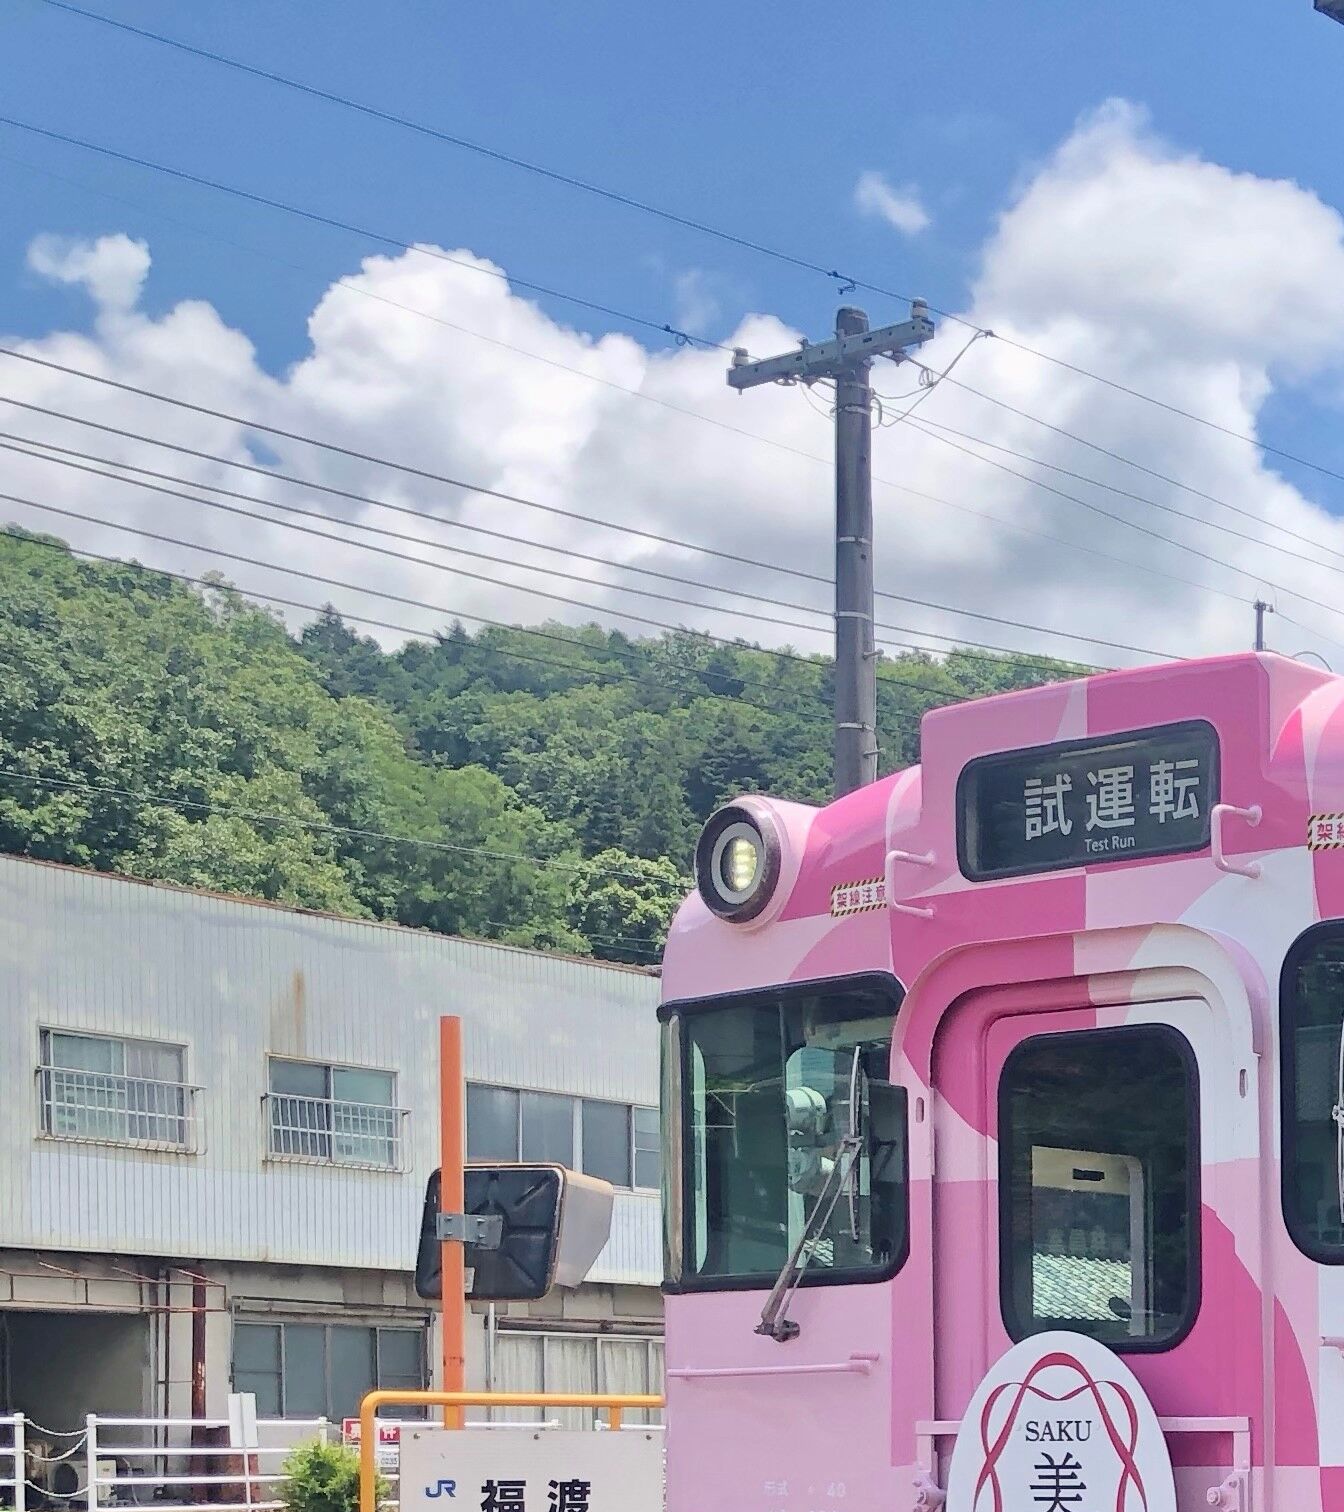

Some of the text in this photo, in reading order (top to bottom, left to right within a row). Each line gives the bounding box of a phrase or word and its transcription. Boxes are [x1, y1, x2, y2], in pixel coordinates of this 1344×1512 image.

[1023, 757, 1200, 842] 試運転
[1084, 833, 1135, 852] Test Run
[1025, 1420, 1093, 1442] SAKU
[425, 1479, 456, 1498] JR
